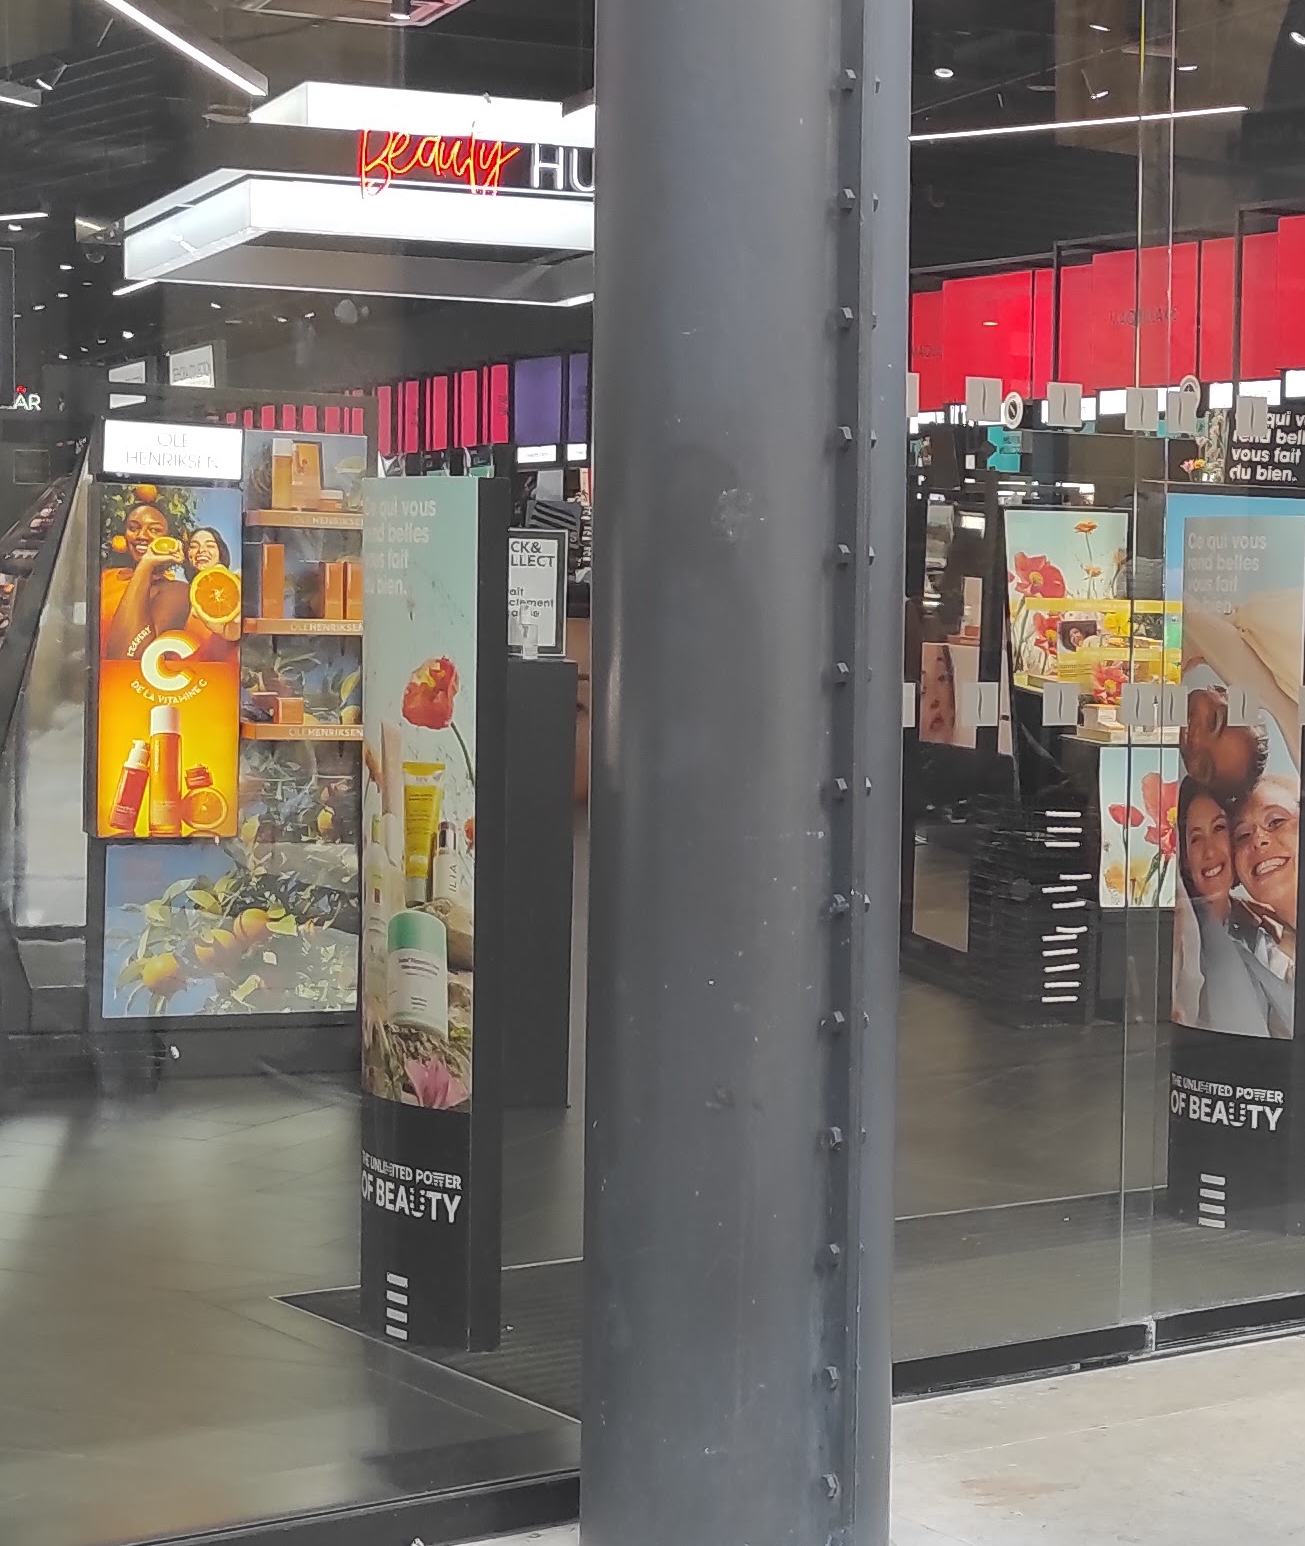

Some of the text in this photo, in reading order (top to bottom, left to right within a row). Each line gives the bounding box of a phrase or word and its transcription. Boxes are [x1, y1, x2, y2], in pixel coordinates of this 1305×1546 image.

[359, 125, 521, 197] Beauty
[157, 433, 188, 447] OLE
[126, 451, 219, 469] HENRIKSEN
[1231, 446, 1302, 465] vous fait
[1229, 463, 1252, 481] du
[401, 499, 437, 517] vous
[388, 522, 429, 543] belles
[1232, 535, 1267, 550] vous
[1217, 554, 1260, 571] belles
[1170, 1089, 1284, 1131] OF BEAUTY
[361, 1169, 461, 1223] OF BEAUTY
